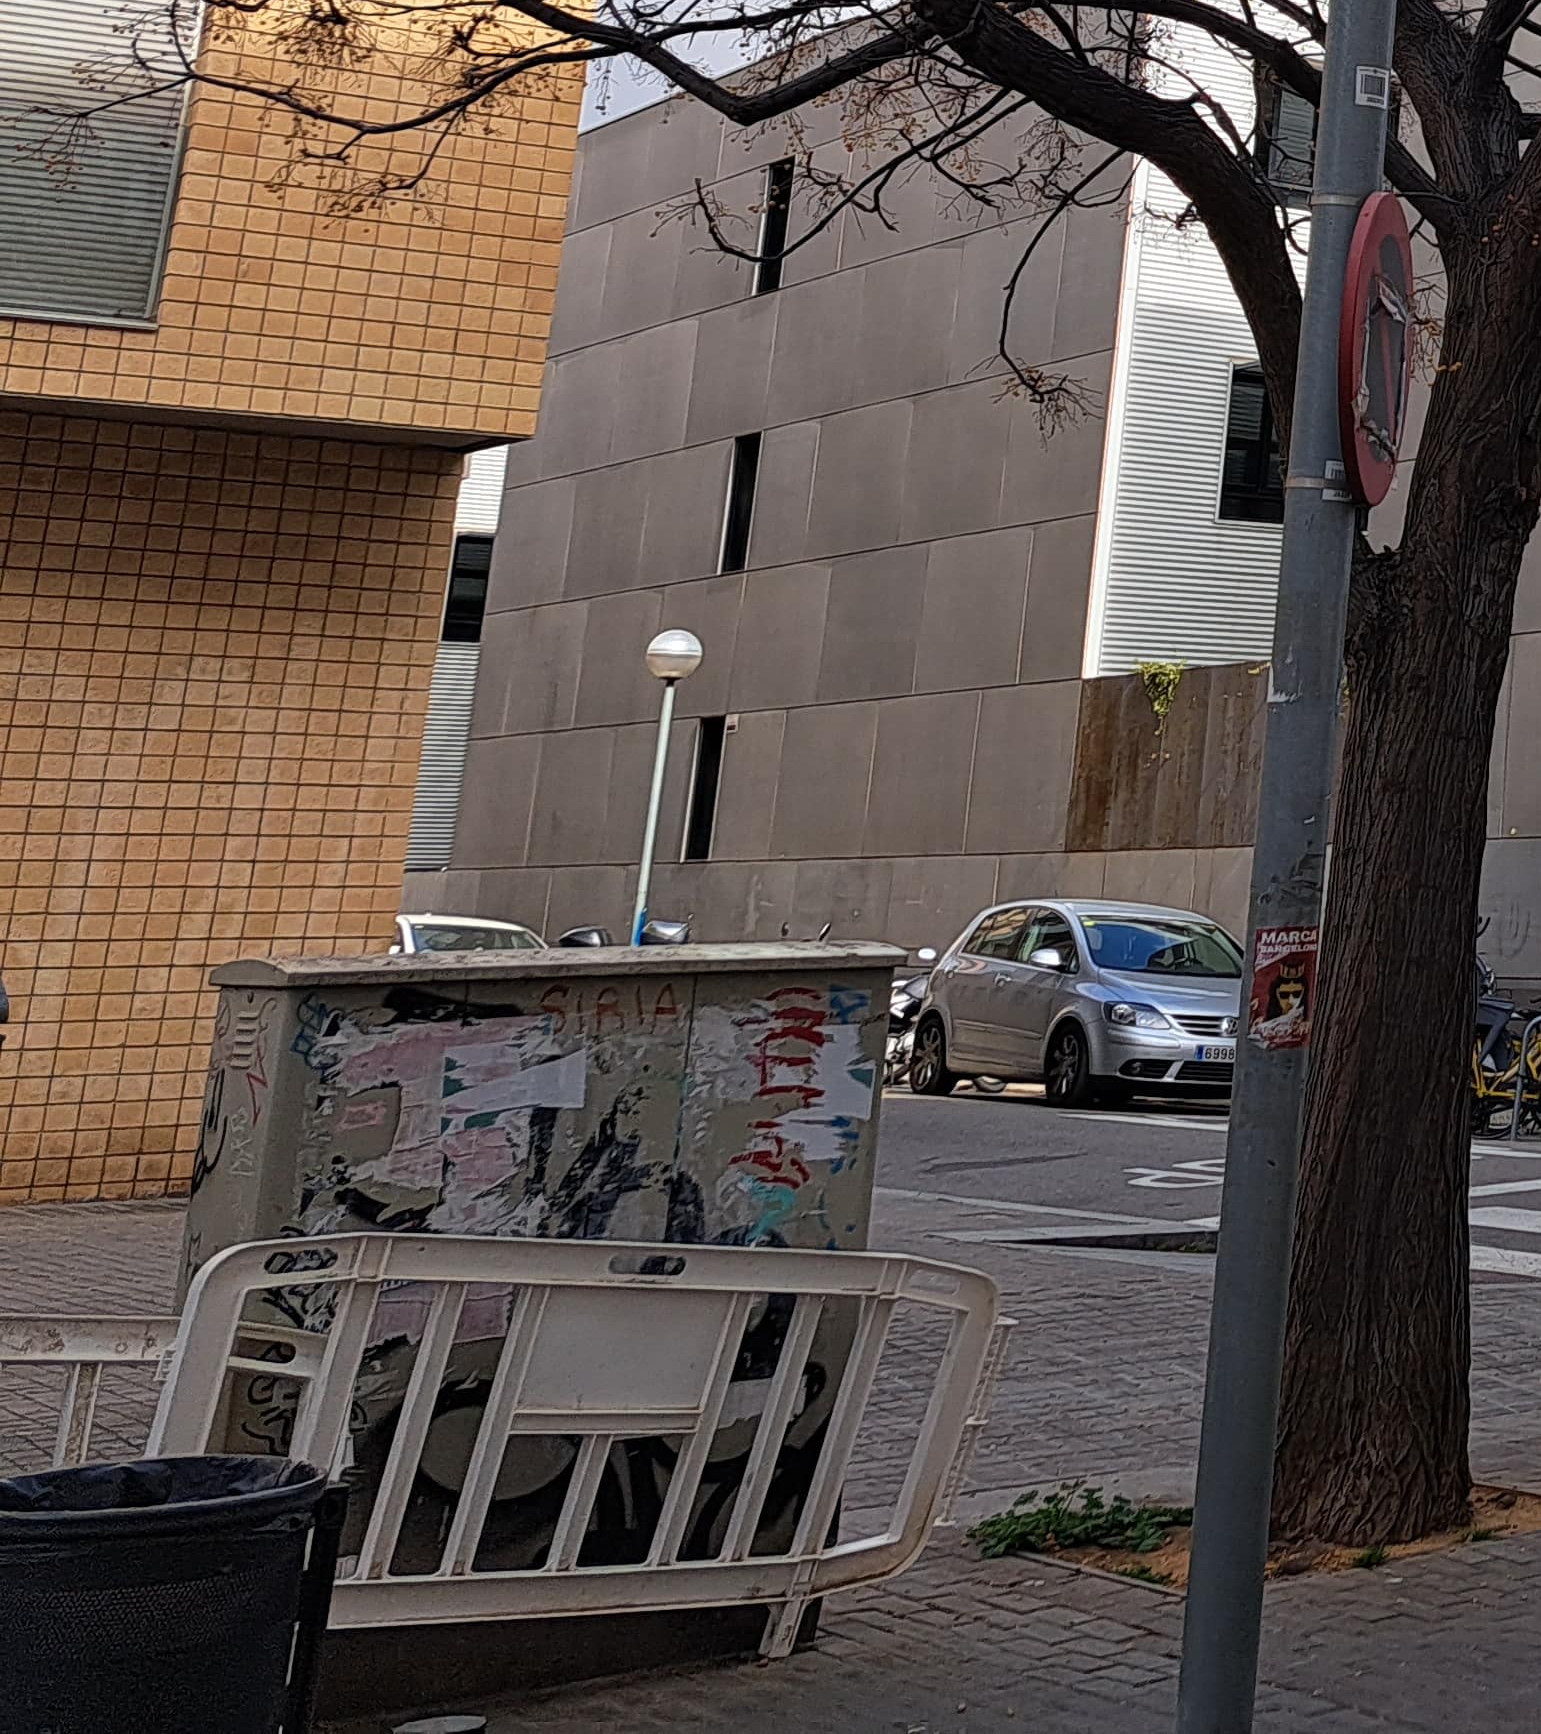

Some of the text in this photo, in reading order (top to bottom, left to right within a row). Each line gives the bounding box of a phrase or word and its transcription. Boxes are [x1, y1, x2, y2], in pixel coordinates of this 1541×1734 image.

[1261, 930, 1317, 944] MARCA
[539, 982, 678, 1034] SIRIA
[1204, 1048, 1235, 1060] 6998
